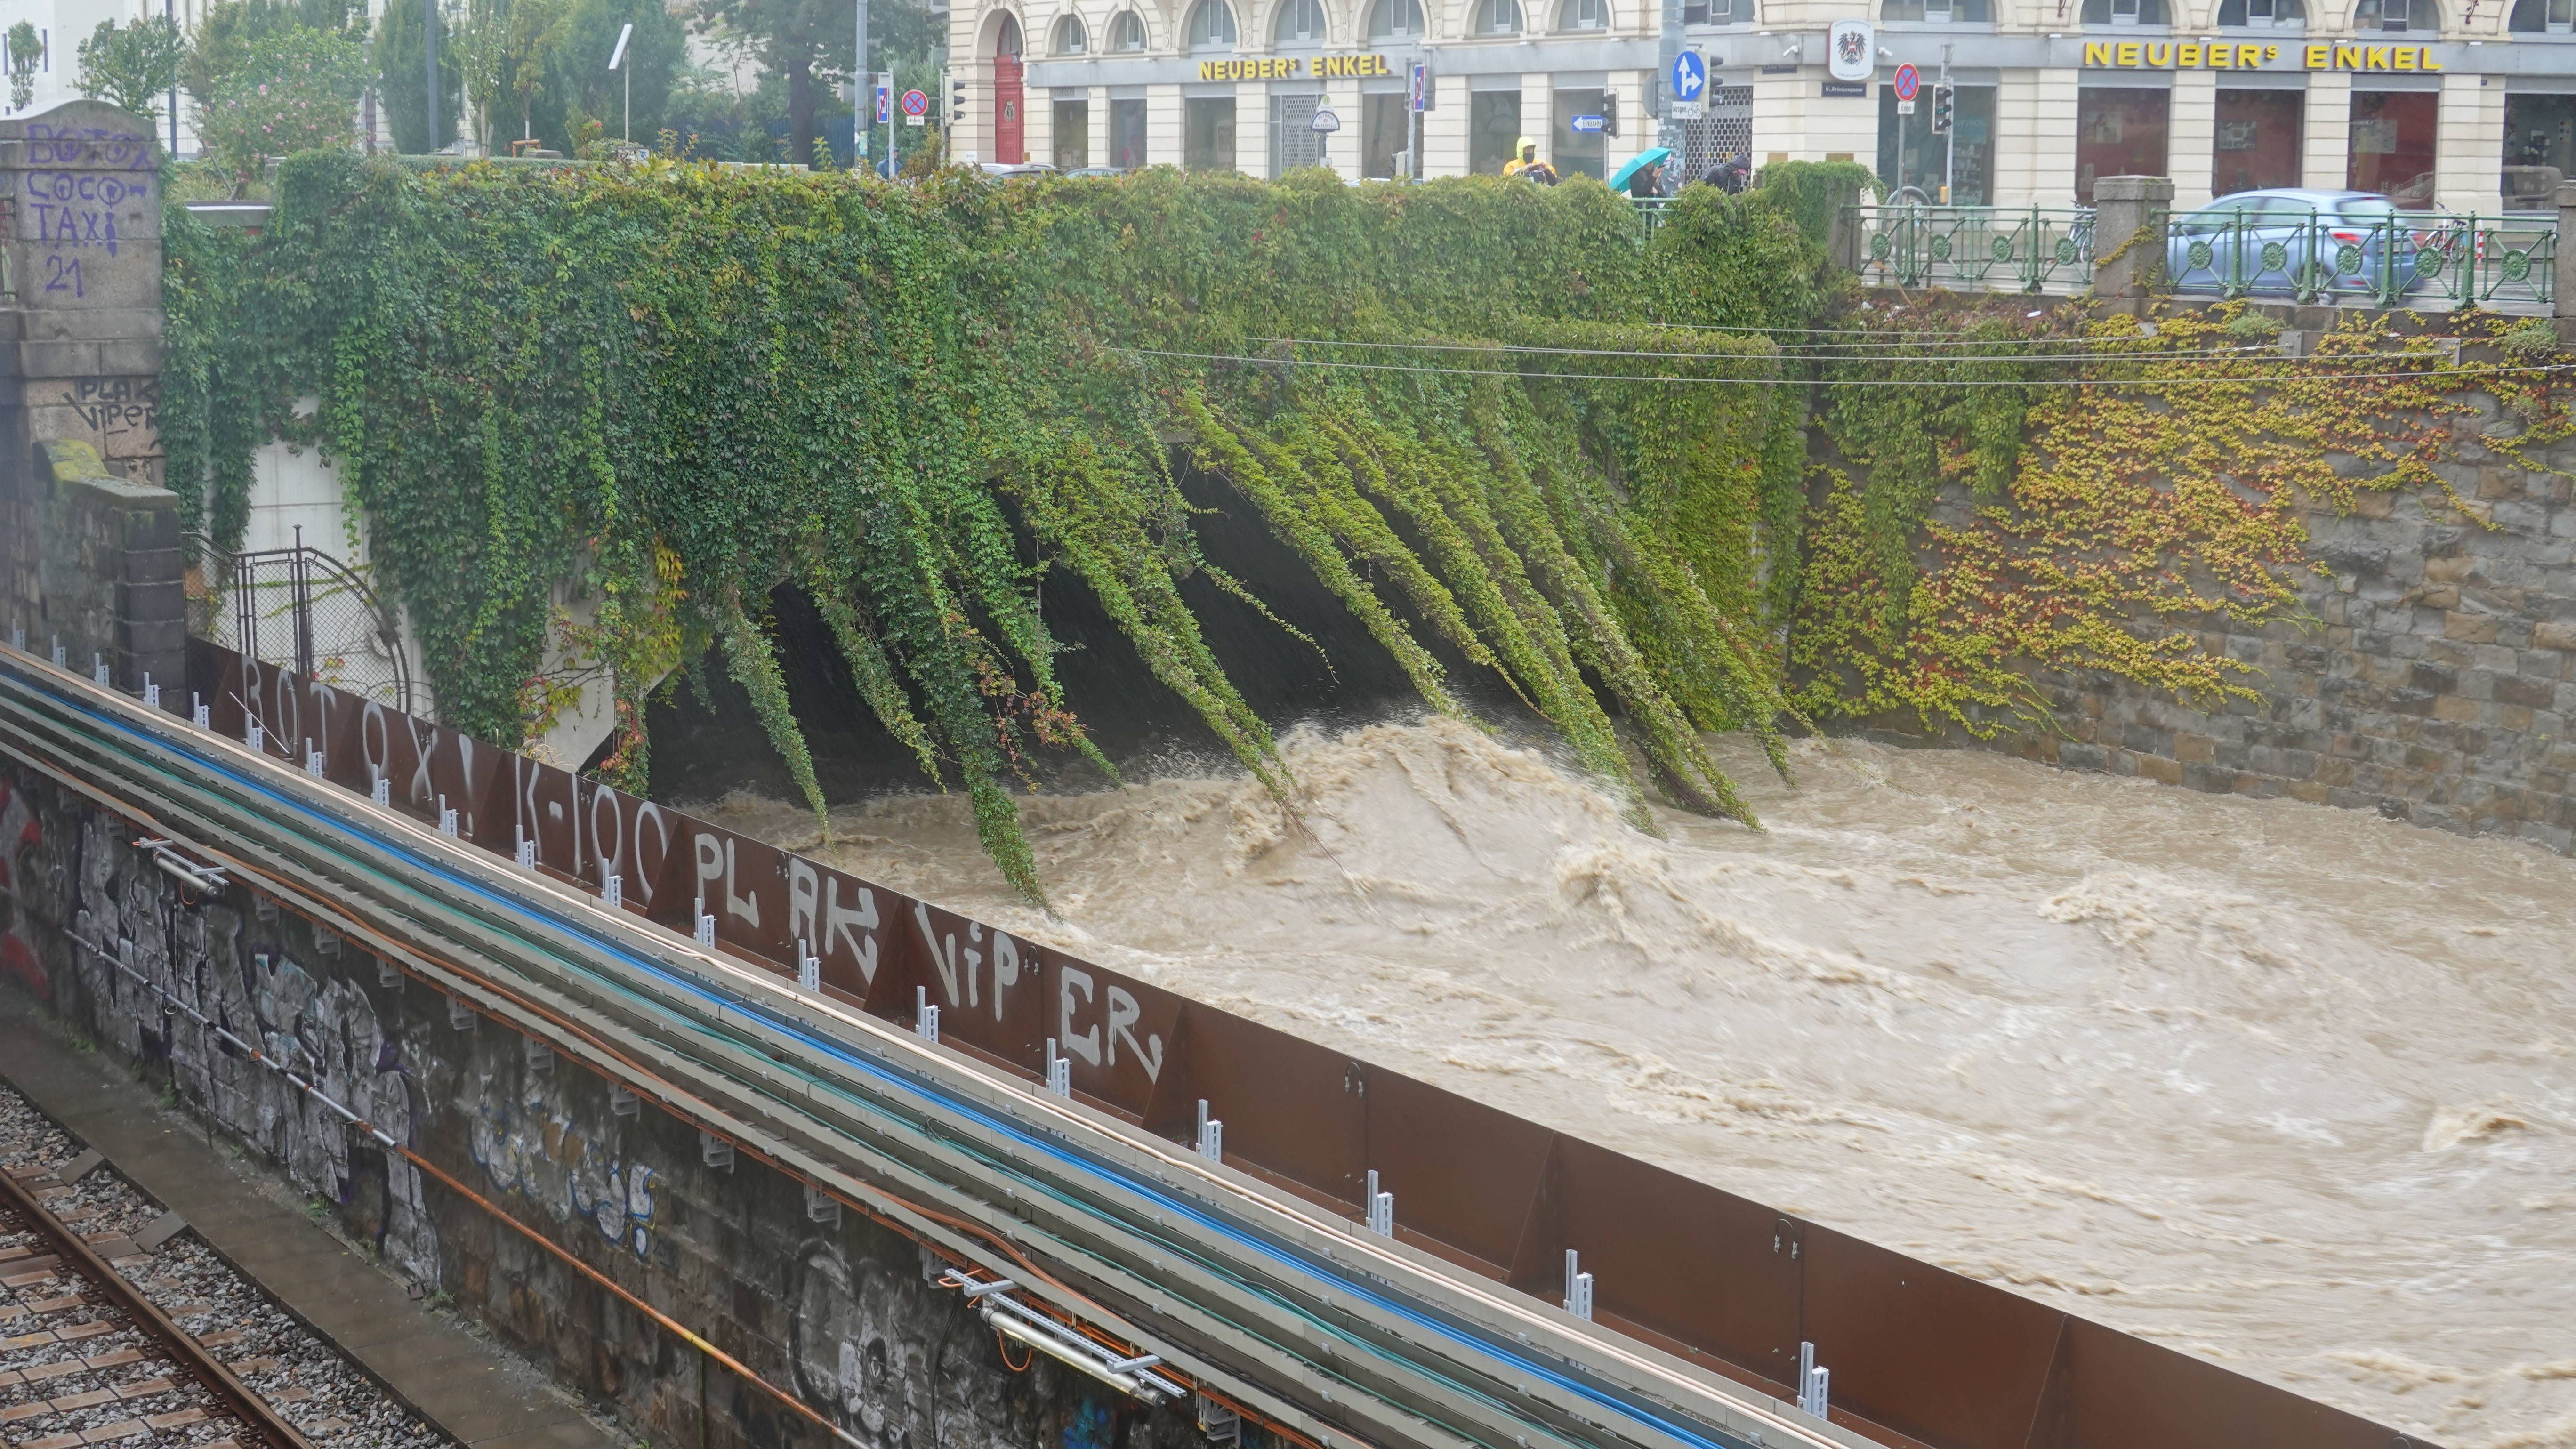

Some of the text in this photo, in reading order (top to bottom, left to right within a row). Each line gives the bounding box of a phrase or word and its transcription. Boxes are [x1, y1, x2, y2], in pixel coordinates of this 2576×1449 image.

[1311, 55, 1387, 76] ENKEL
[2305, 45, 2443, 70] ENKEL
[1318, 113, 1334, 121] AUTOBUS
[1673, 106, 1688, 114] ausgen.
[27, 123, 157, 180] BOTOX
[695, 833, 879, 985] PLAK
